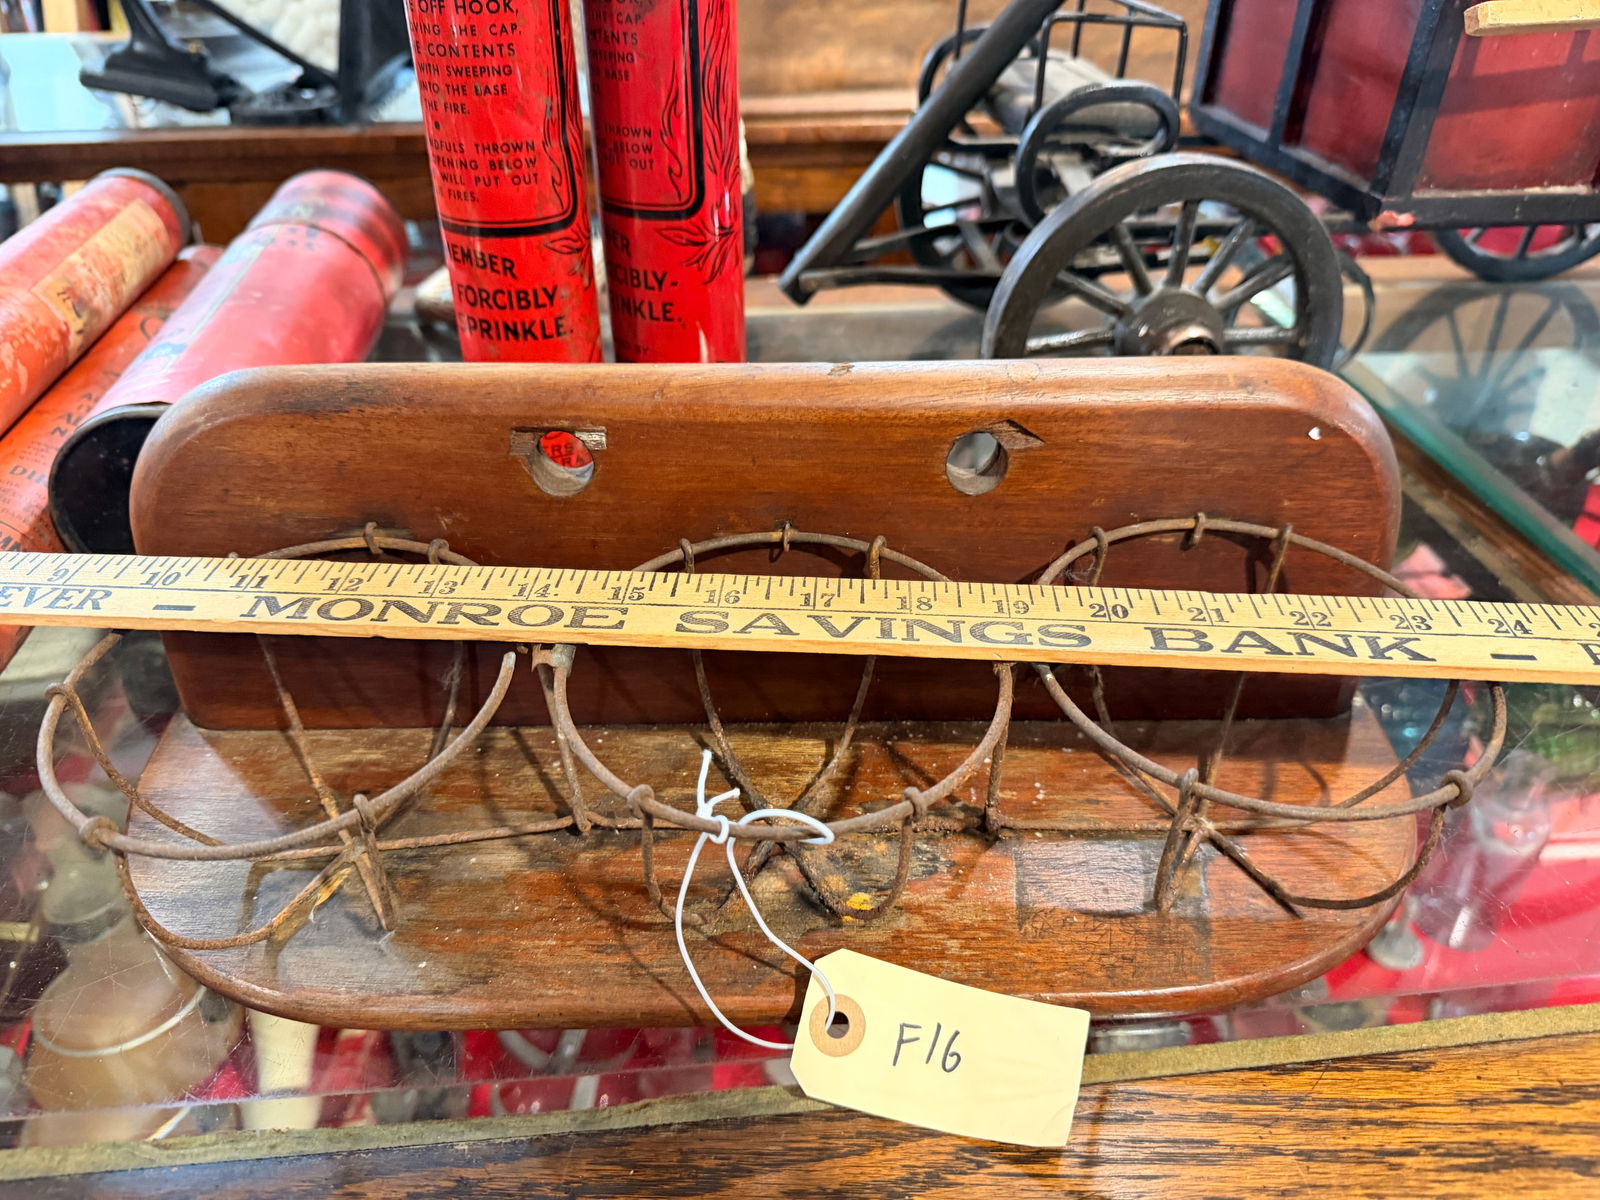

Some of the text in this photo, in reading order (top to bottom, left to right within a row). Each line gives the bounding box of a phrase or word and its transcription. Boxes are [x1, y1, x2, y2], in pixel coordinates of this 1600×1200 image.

[418, 0, 446, 14] OFF
[455, 0, 519, 16] HOOK,
[489, 23, 522, 37] CAP.
[427, 43, 516, 58] CONTENTS
[418, 62, 513, 78] WITH SWEEPING
[445, 83, 468, 97] THE
[443, 102, 471, 115] FIRE.
[474, 140, 536, 155] THROWN
[489, 157, 538, 171] BELOW
[629, 158, 654, 171] OUT
[440, 172, 539, 188] WILL PUT OUT
[456, 284, 558, 311] FORCIBLY
[46, 567, 1533, 635] 9 10 11 12 13 14 15 16 17 18 19 20 21 22 23 24
[0, 585, 113, 611] EVER
[239, 595, 629, 631] MONROE
[675, 609, 1092, 648] SAVINGS
[1143, 626, 1437, 662] BANK
[892, 1021, 962, 1074] F16
